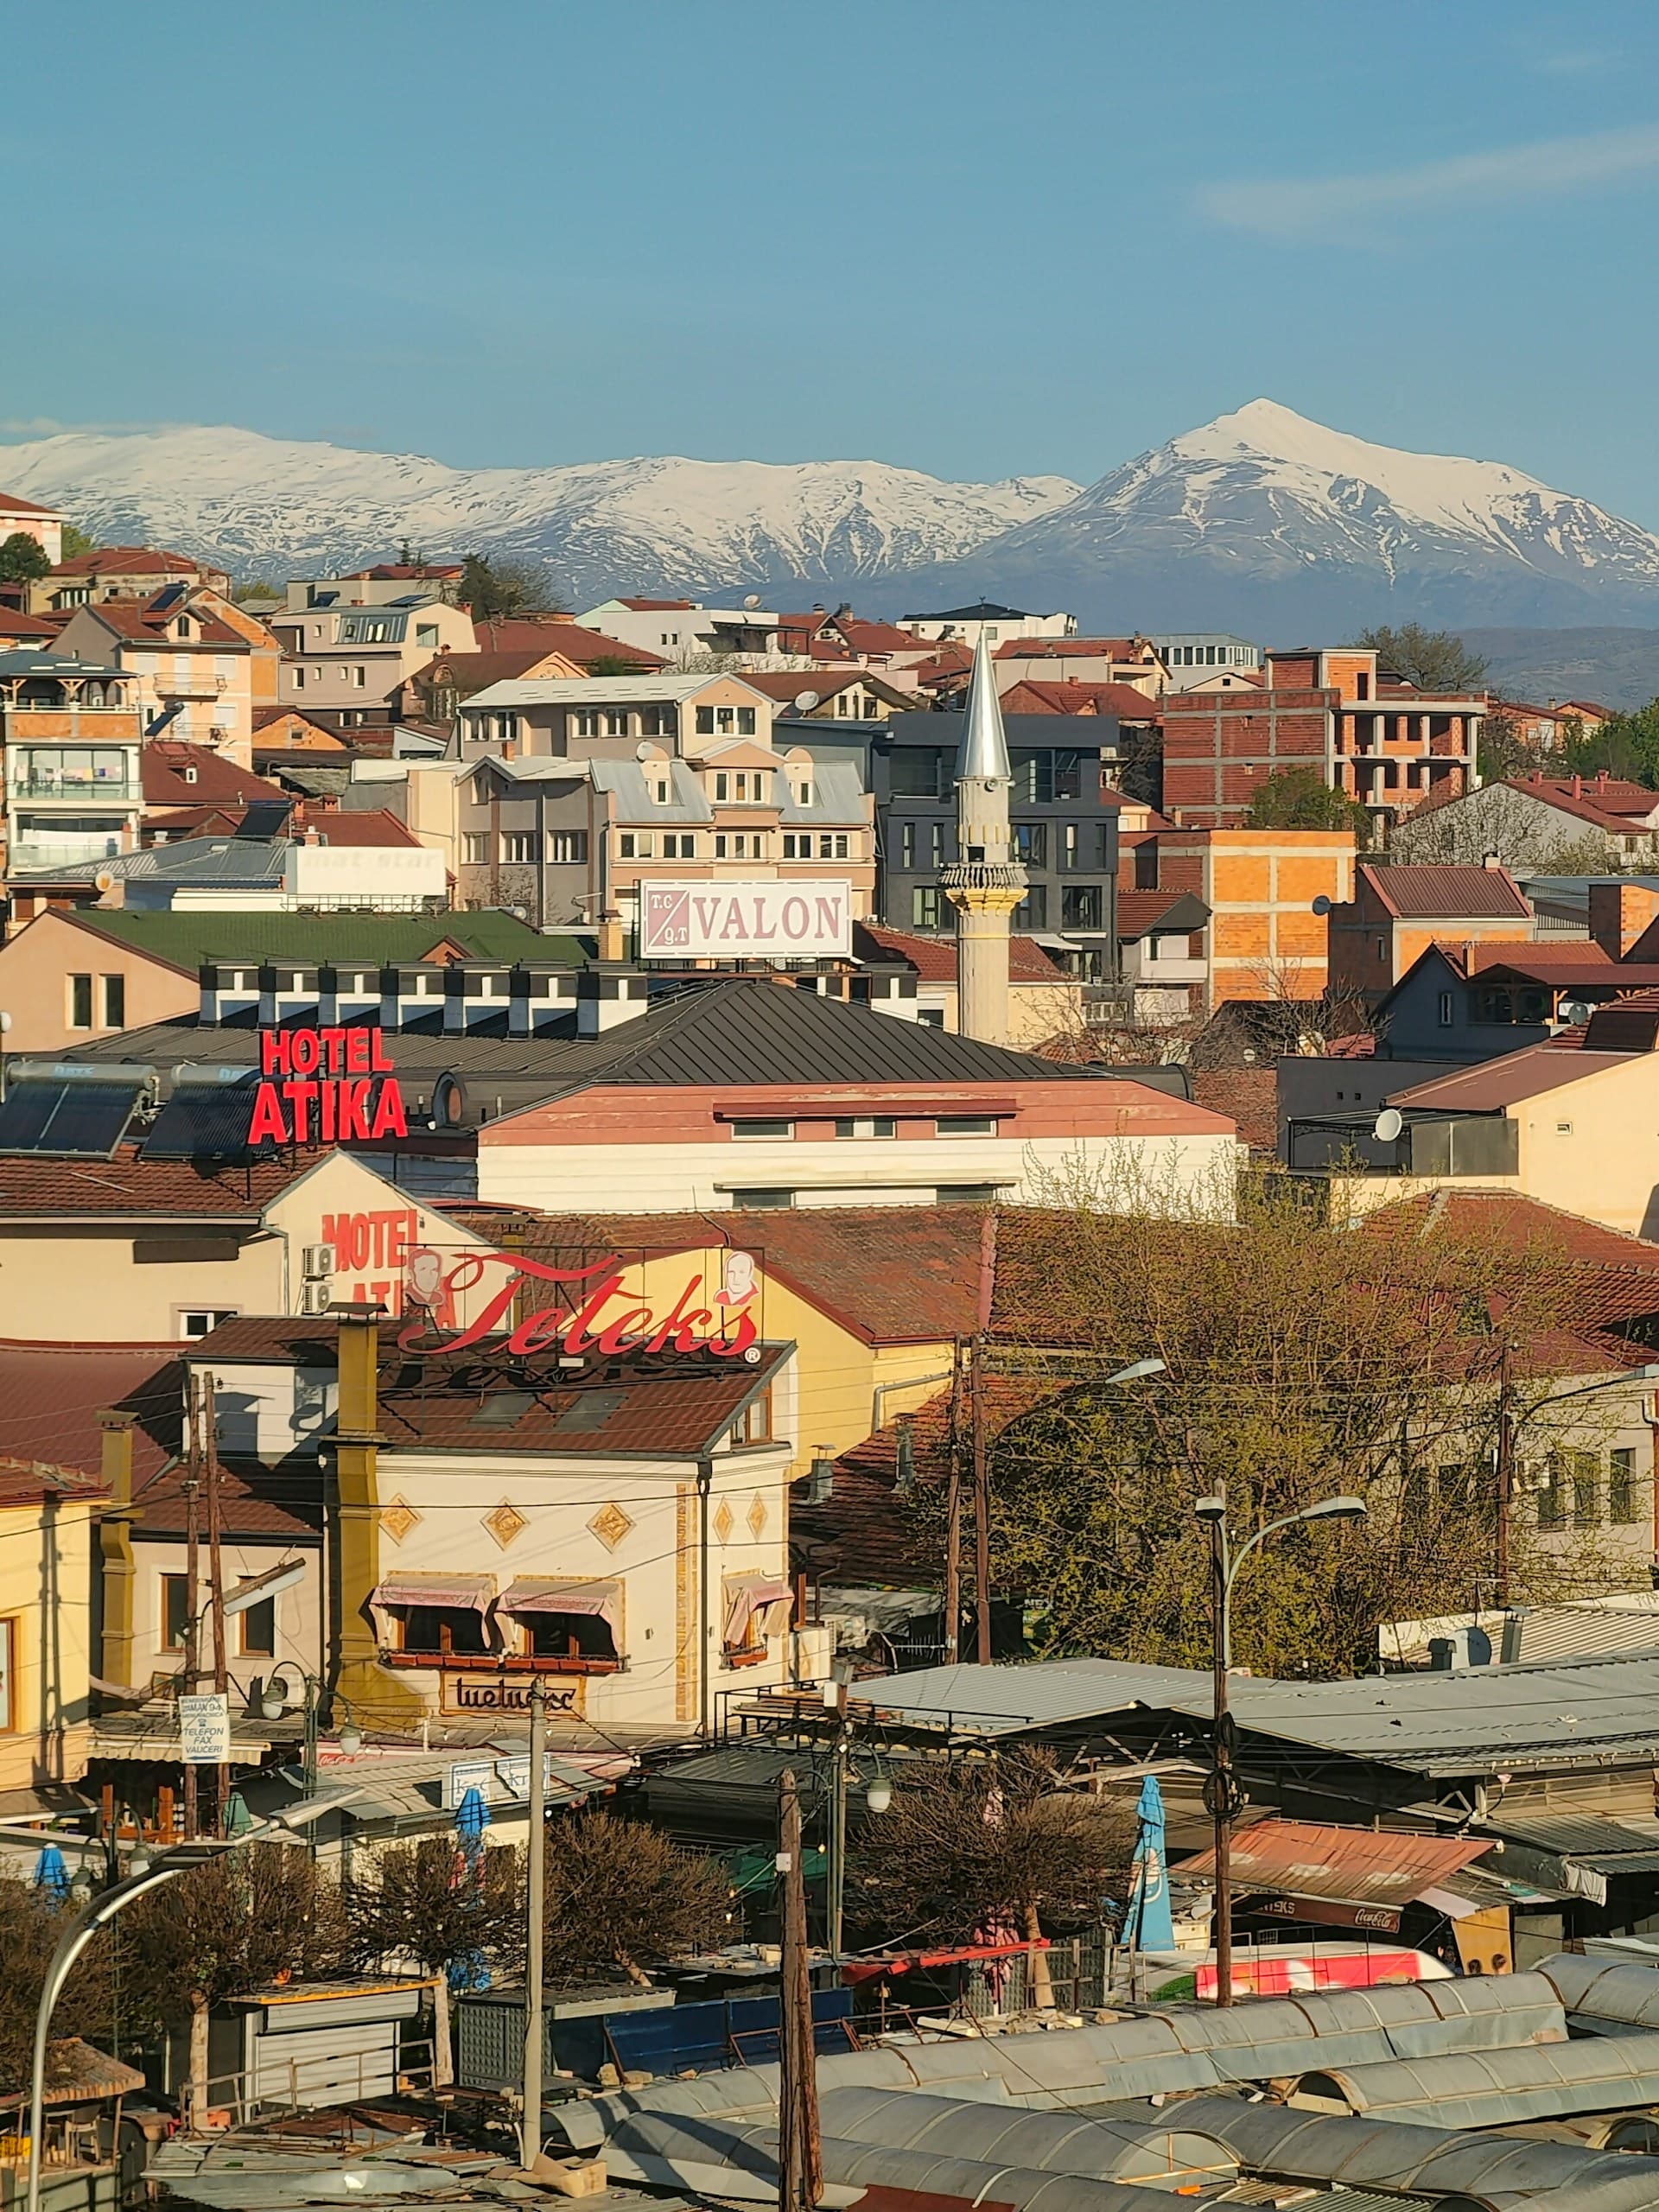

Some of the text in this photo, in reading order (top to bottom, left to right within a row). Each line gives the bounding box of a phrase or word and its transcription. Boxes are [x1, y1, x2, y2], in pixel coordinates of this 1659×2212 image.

[692, 896, 842, 940] VALON
[263, 1027, 395, 1076] HOTEL
[247, 1078, 409, 1145] ATIKA
[397, 1253, 758, 1357] Teteks
[183, 1727, 225, 1736] TELEFON
[194, 1736, 213, 1745] FAX
